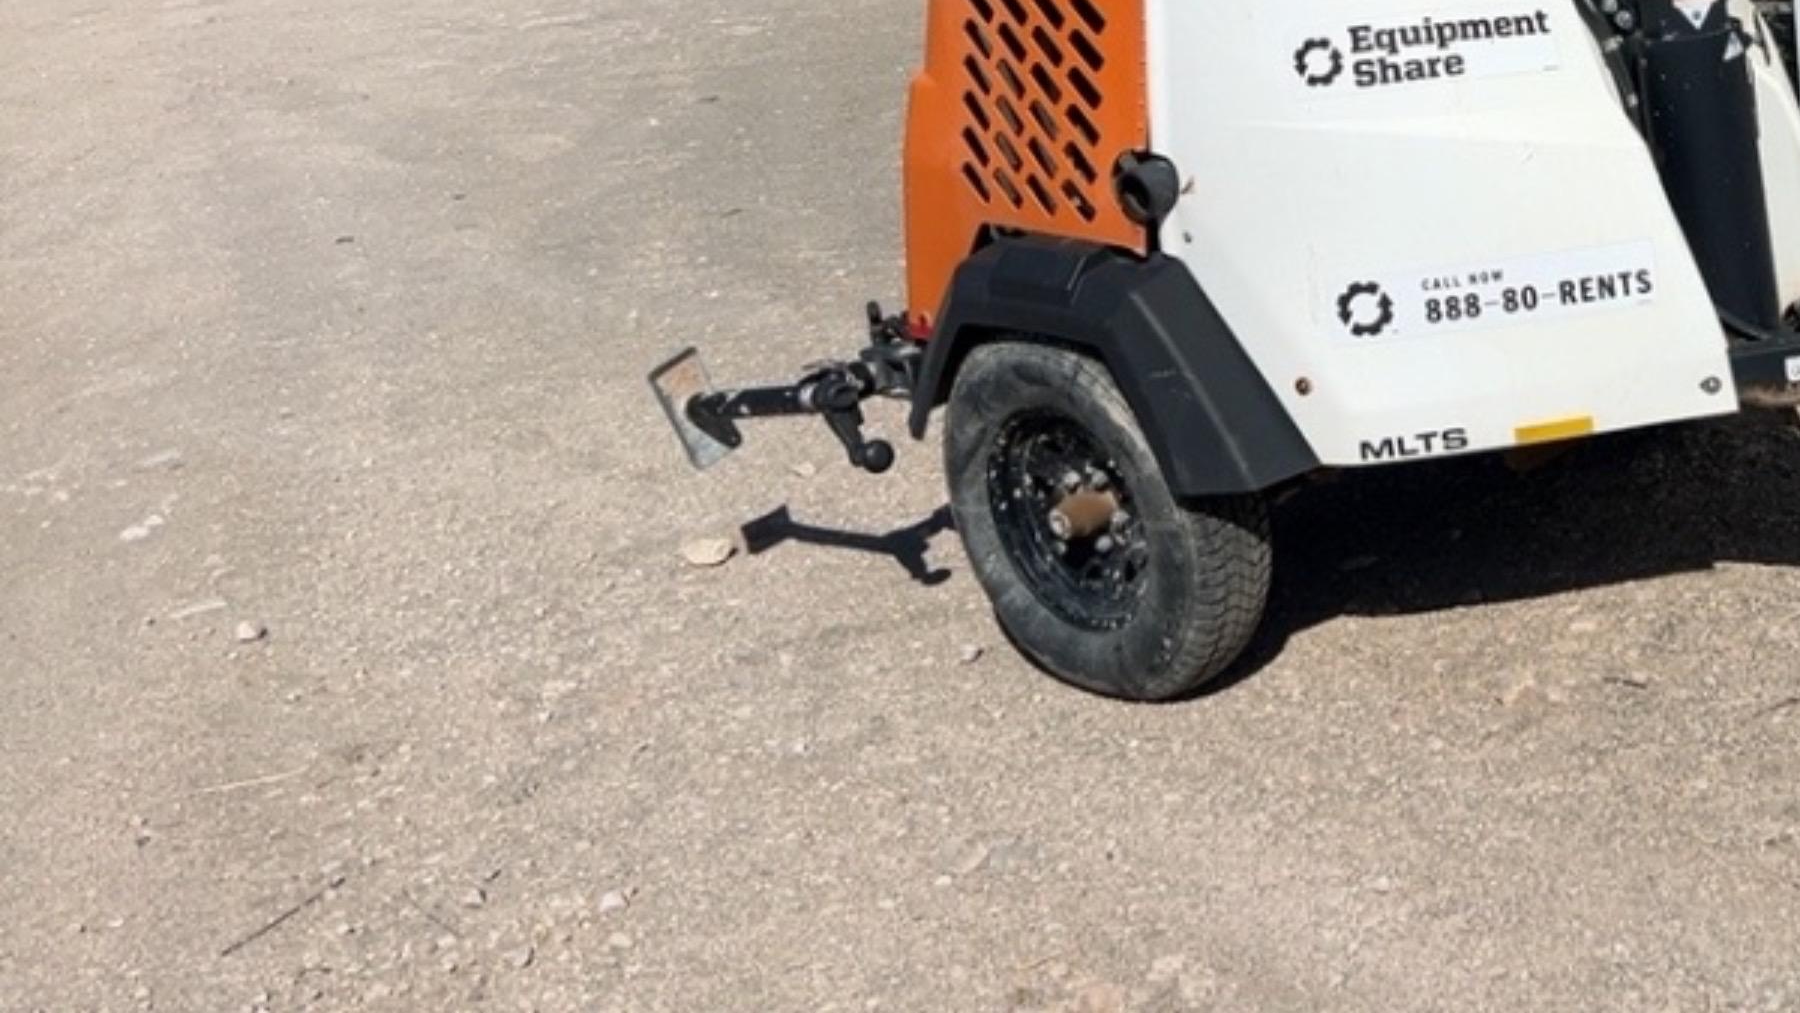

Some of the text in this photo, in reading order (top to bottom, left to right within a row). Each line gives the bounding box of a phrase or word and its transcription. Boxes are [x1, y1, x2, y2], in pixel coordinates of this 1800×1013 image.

[1348, 9, 1550, 56] Equipment
[1353, 52, 1465, 87] Share
[1425, 269, 1653, 324] 888-80-RENTS
[1359, 428, 1468, 461] MLTS
